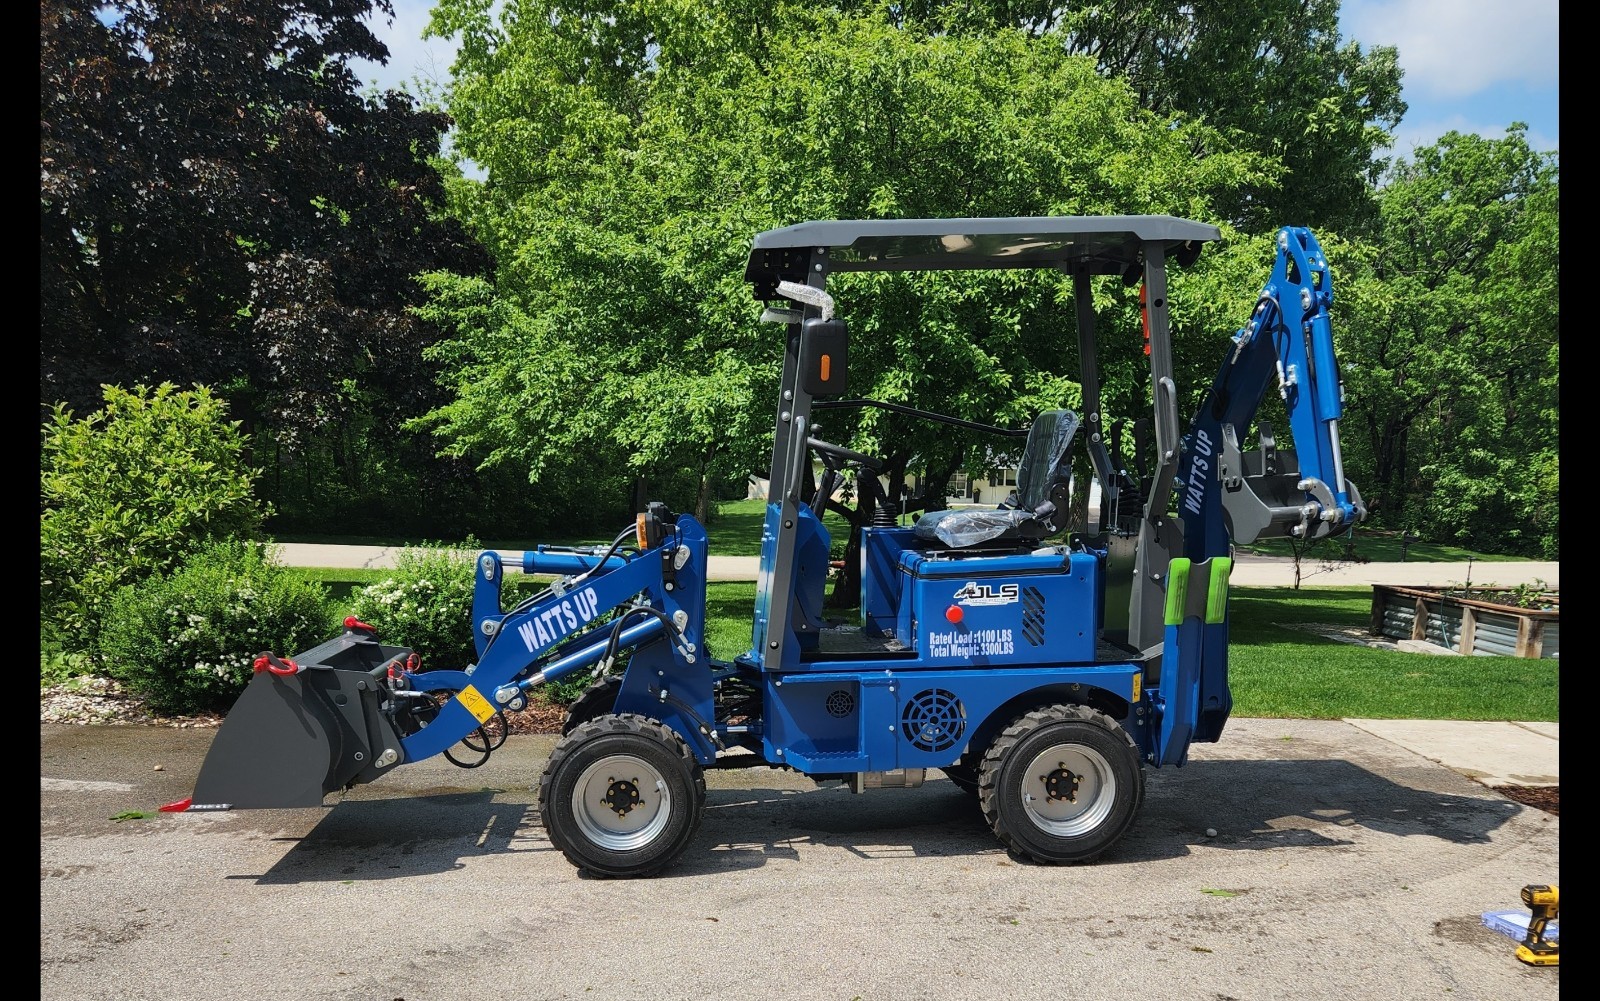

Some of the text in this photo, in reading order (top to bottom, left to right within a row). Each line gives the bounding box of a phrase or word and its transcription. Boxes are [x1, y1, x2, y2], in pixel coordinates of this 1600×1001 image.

[1184, 429, 1213, 515] WATTS UP
[517, 587, 598, 654] WATTS UP
[929, 632, 952, 644] Rated
[953, 630, 973, 644] Load
[996, 629, 1012, 642] LBS
[929, 644, 949, 657] Total
[950, 643, 979, 659] Weight:
